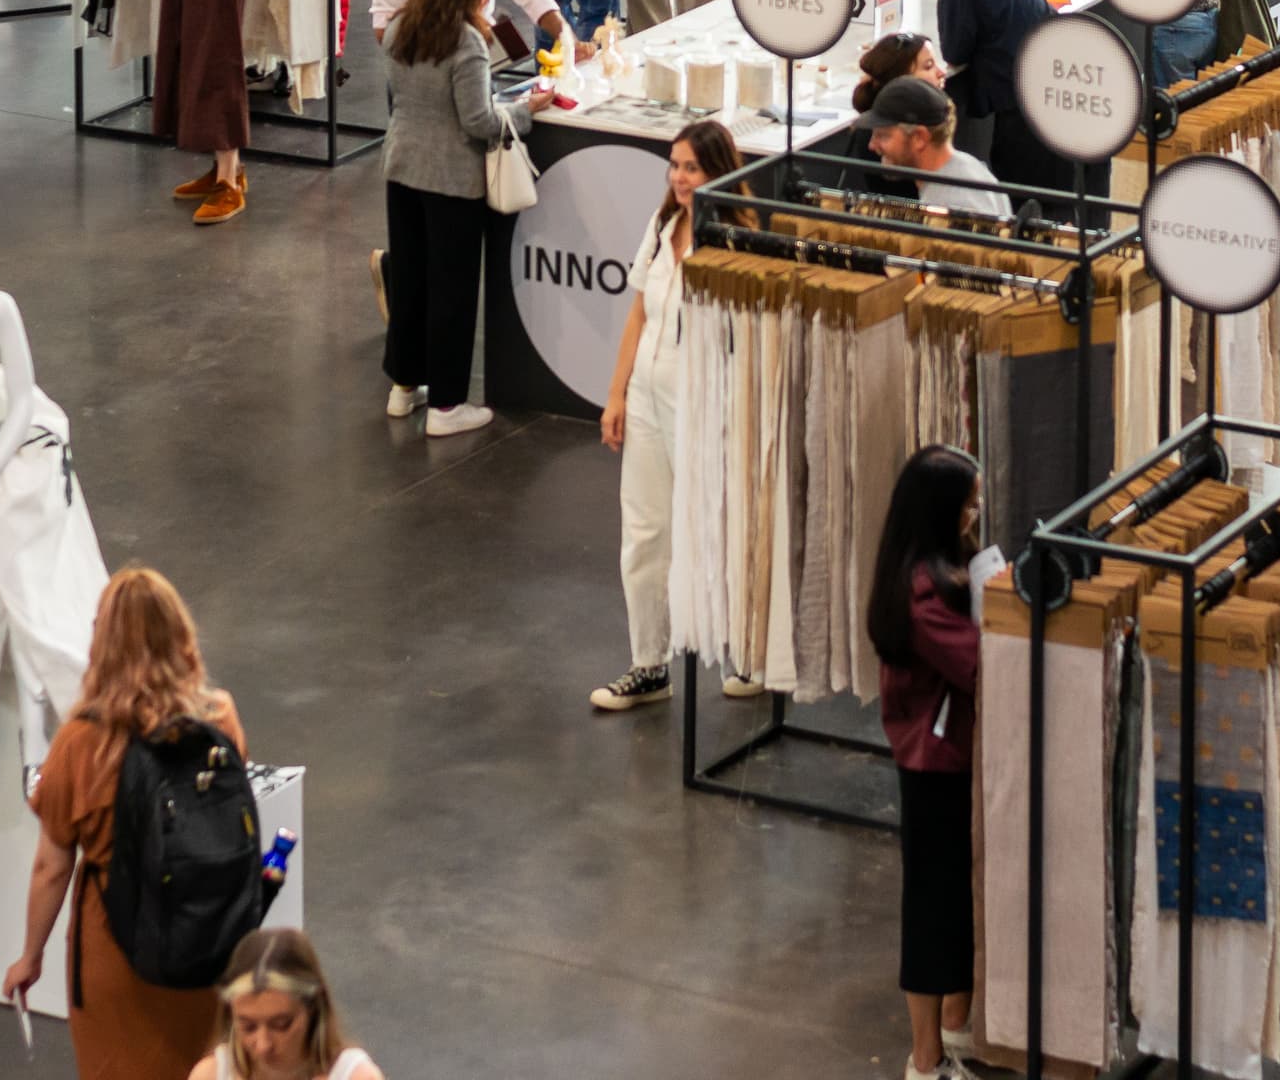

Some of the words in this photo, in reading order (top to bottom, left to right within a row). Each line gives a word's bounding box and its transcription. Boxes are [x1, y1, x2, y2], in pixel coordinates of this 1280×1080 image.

[1052, 58, 1105, 87] BAST
[1043, 86, 1113, 118] FIBRES
[1150, 219, 1280, 255] REGENERATIVE
[523, 244, 634, 295] INNO
